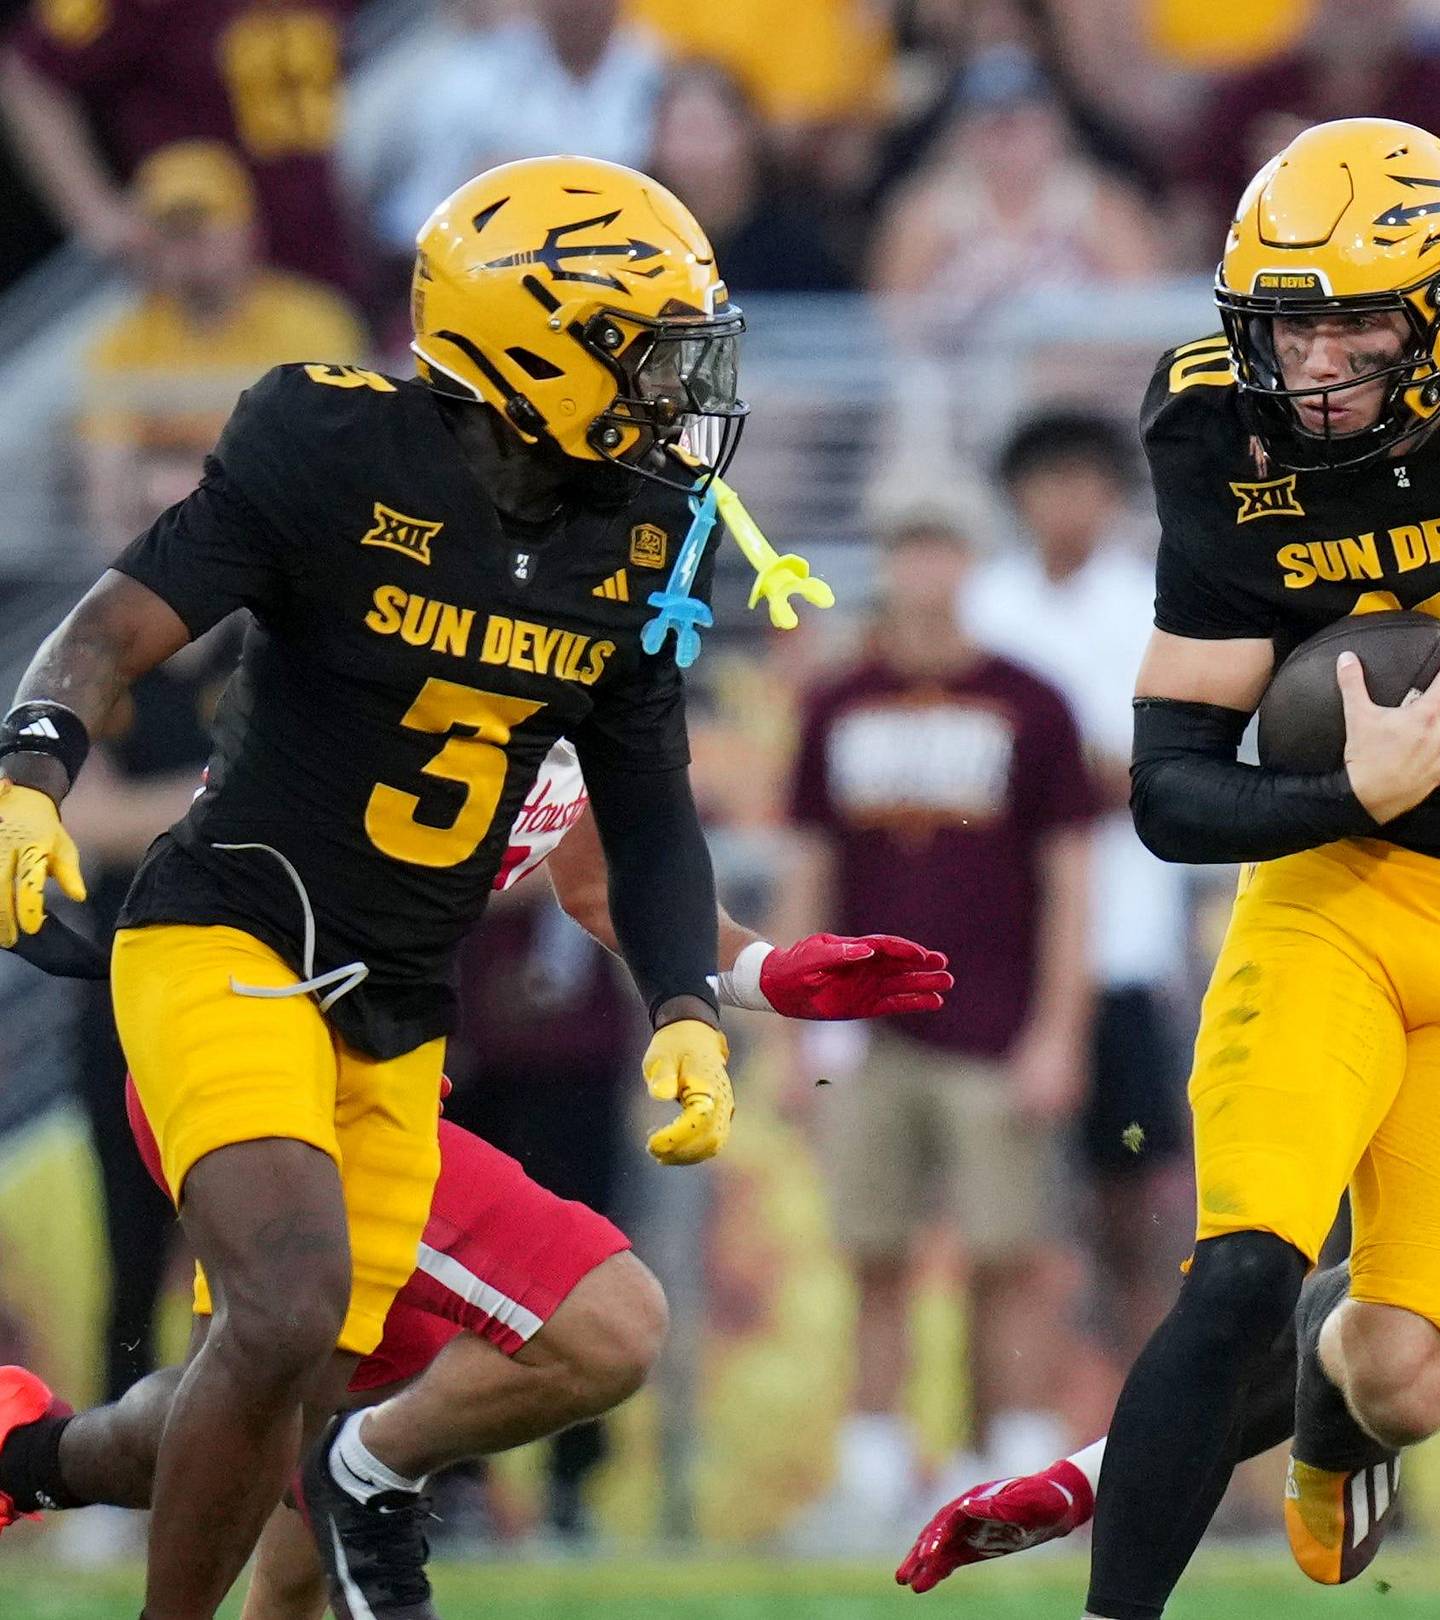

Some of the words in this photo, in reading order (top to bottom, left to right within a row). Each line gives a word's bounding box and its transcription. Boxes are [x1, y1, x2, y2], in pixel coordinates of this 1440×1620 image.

[1260, 275, 1279, 288] SUN
[1280, 275, 1315, 289] DEVILS
[1235, 478, 1301, 520] XII
[366, 508, 438, 560] XII
[1276, 533, 1383, 590] SUN
[365, 584, 477, 658] SUN
[480, 614, 616, 687] DEVILS
[364, 677, 549, 868] 3
